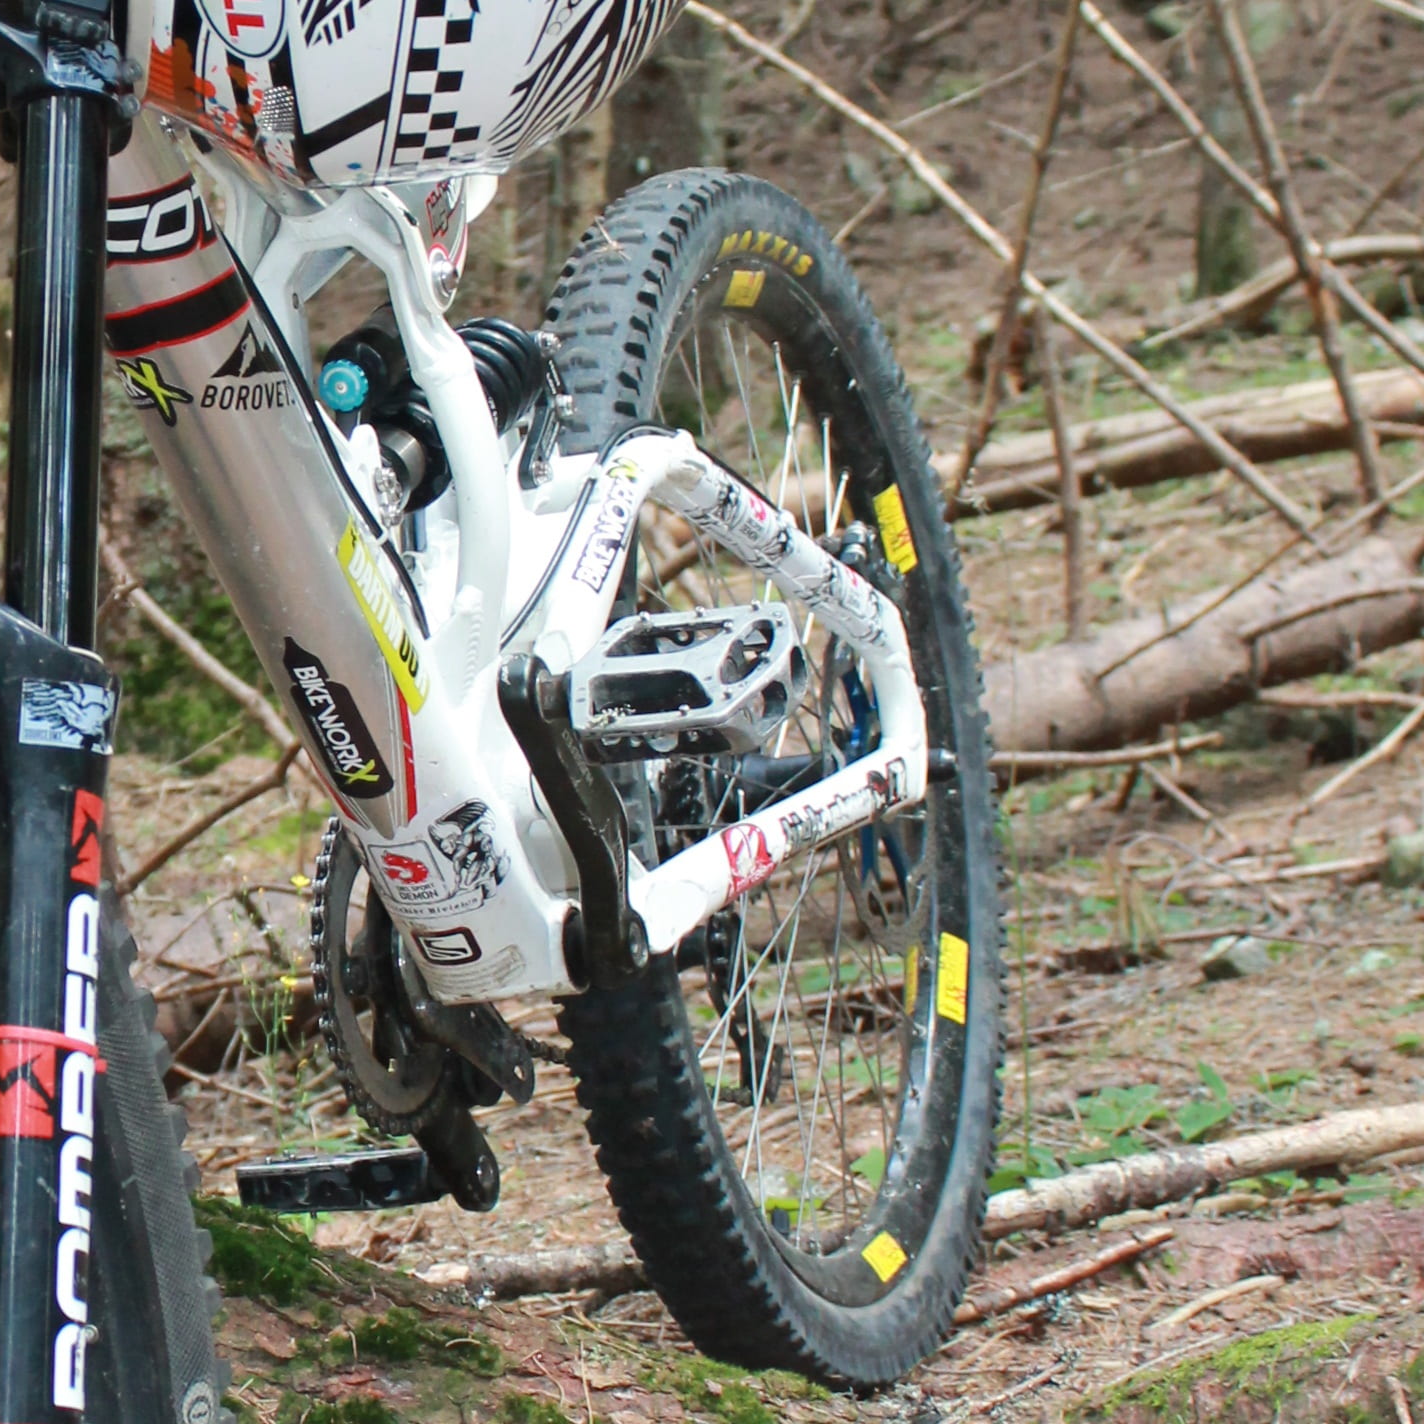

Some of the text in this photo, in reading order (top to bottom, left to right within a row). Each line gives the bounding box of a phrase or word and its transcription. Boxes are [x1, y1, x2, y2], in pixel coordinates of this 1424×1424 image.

[105, 183, 213, 253] COT
[716, 229, 814, 276] MAXXIS
[200, 383, 297, 411] BOROVET
